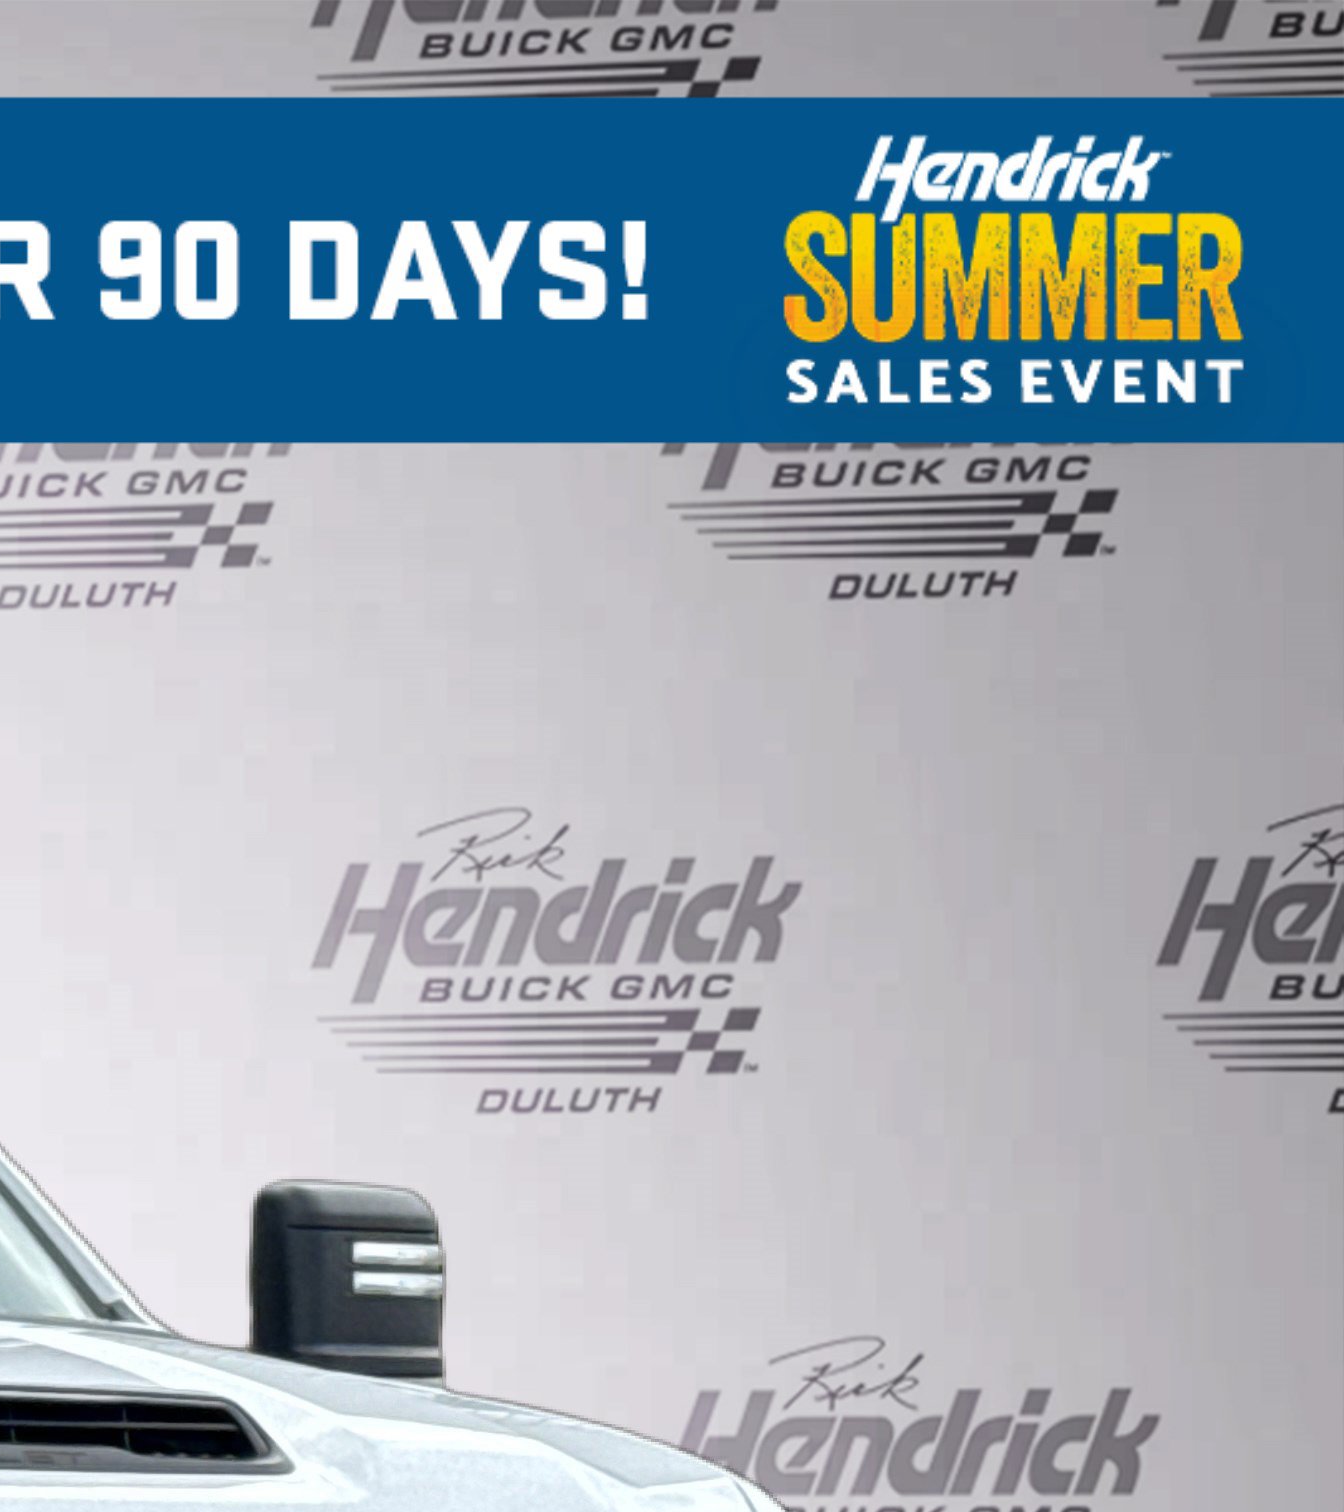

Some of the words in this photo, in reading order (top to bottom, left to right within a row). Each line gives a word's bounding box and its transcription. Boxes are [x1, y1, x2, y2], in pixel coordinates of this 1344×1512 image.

[419, 27, 593, 60] BUICK
[610, 22, 735, 53] GMC
[126, 468, 248, 496] GMC
[770, 457, 946, 489] BUICK
[964, 455, 1092, 485] GMC
[827, 569, 1019, 601] DULUTH
[309, 855, 803, 1005] Hendrick
[419, 974, 592, 1003] BUICK
[609, 973, 735, 1000] GMC
[475, 1087, 663, 1115] DULUTH
